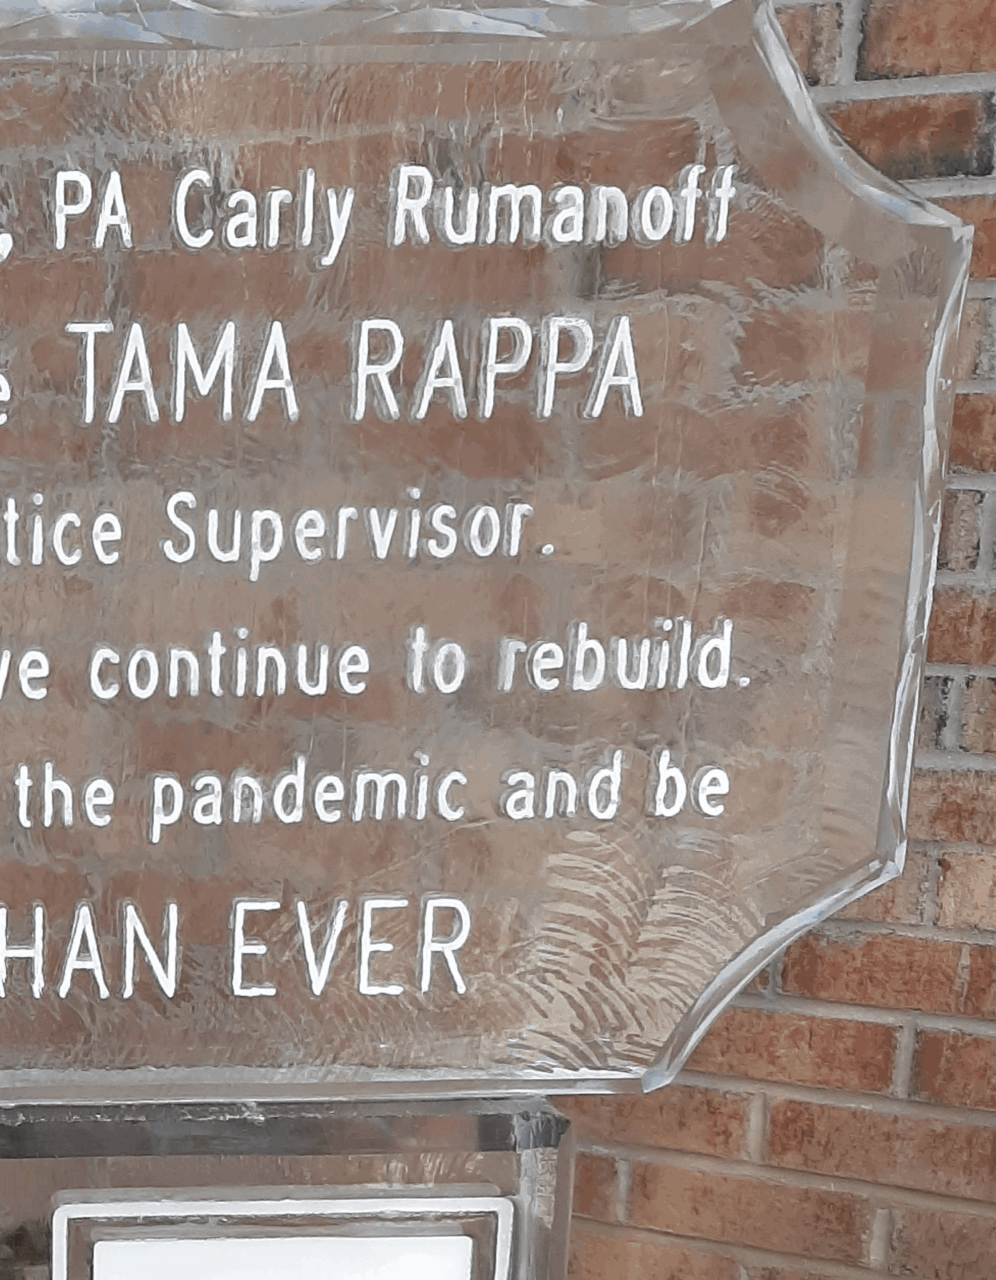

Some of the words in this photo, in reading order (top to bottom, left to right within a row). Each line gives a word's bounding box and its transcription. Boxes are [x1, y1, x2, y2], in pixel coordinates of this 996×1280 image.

[54, 170, 133, 250] PA
[173, 166, 355, 267] Carly
[390, 164, 737, 248] Rumanoff
[65, 320, 298, 423] TAMA
[350, 315, 644, 421] RAPPA
[163, 488, 555, 582] Supervisor.
[89, 627, 370, 699] continue
[409, 625, 465, 694] to
[498, 616, 752, 692] rebuild.
[15, 761, 114, 828] the
[151, 750, 468, 844] pandemic
[504, 749, 623, 821] and
[654, 749, 731, 819] be
[230, 899, 472, 998] EVER
